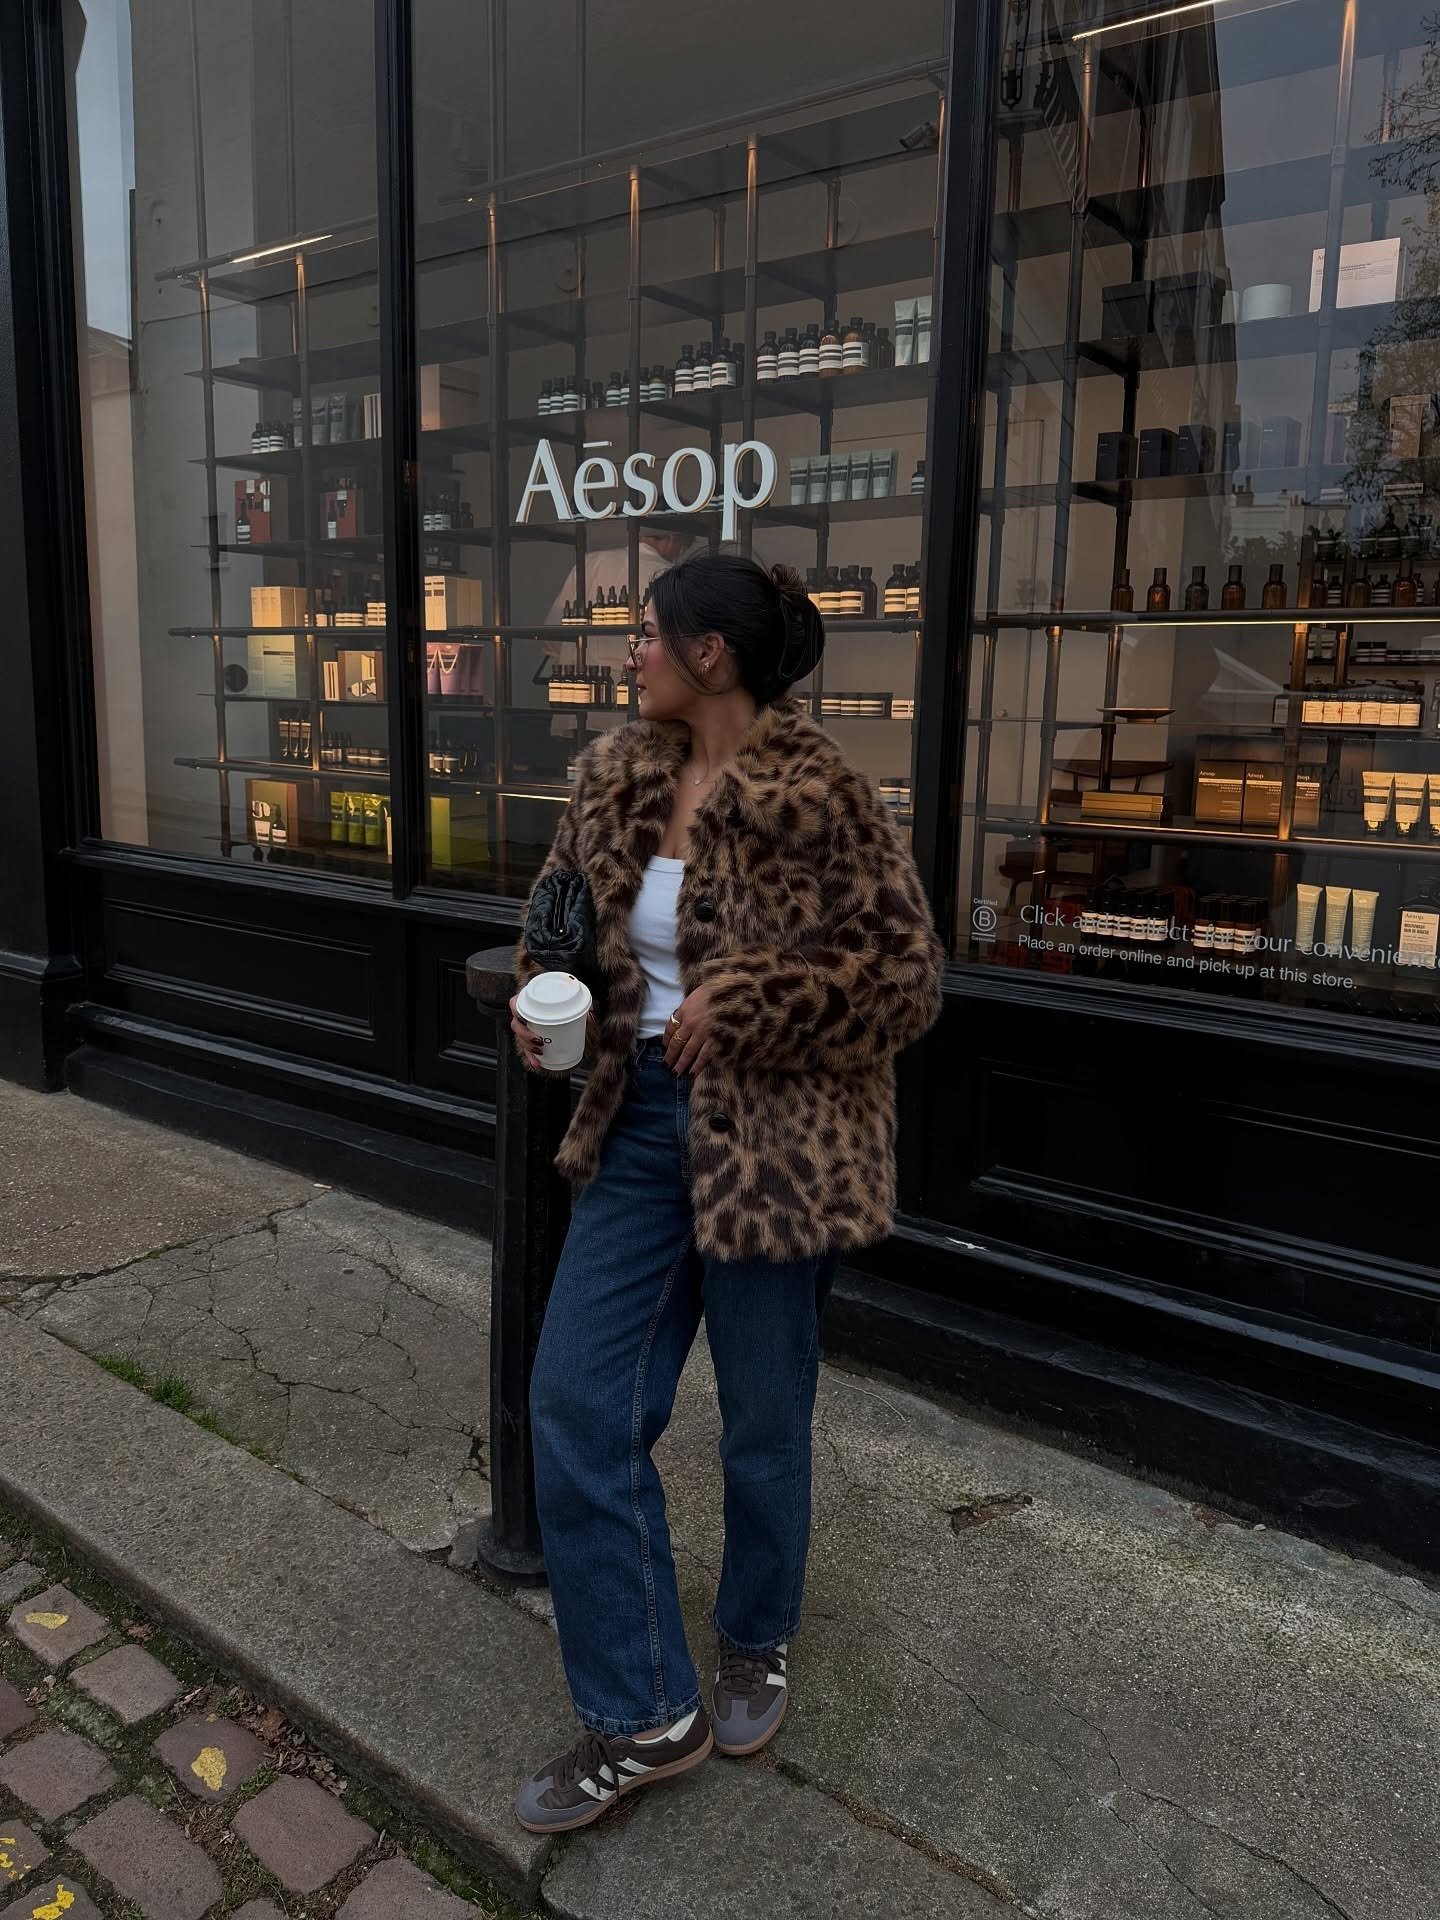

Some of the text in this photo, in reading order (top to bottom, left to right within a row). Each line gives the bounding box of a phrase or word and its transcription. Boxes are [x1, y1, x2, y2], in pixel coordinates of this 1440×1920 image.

[973, 898, 998, 906] Certified
[1018, 934, 1357, 989] Place an order online and pick up at this store.
[1020, 904, 1066, 927] Click
[1072, 912, 1109, 930] and
[1205, 923, 1234, 944] for
[1242, 935, 1292, 955] your
[1299, 940, 1440, 969] convenienc
